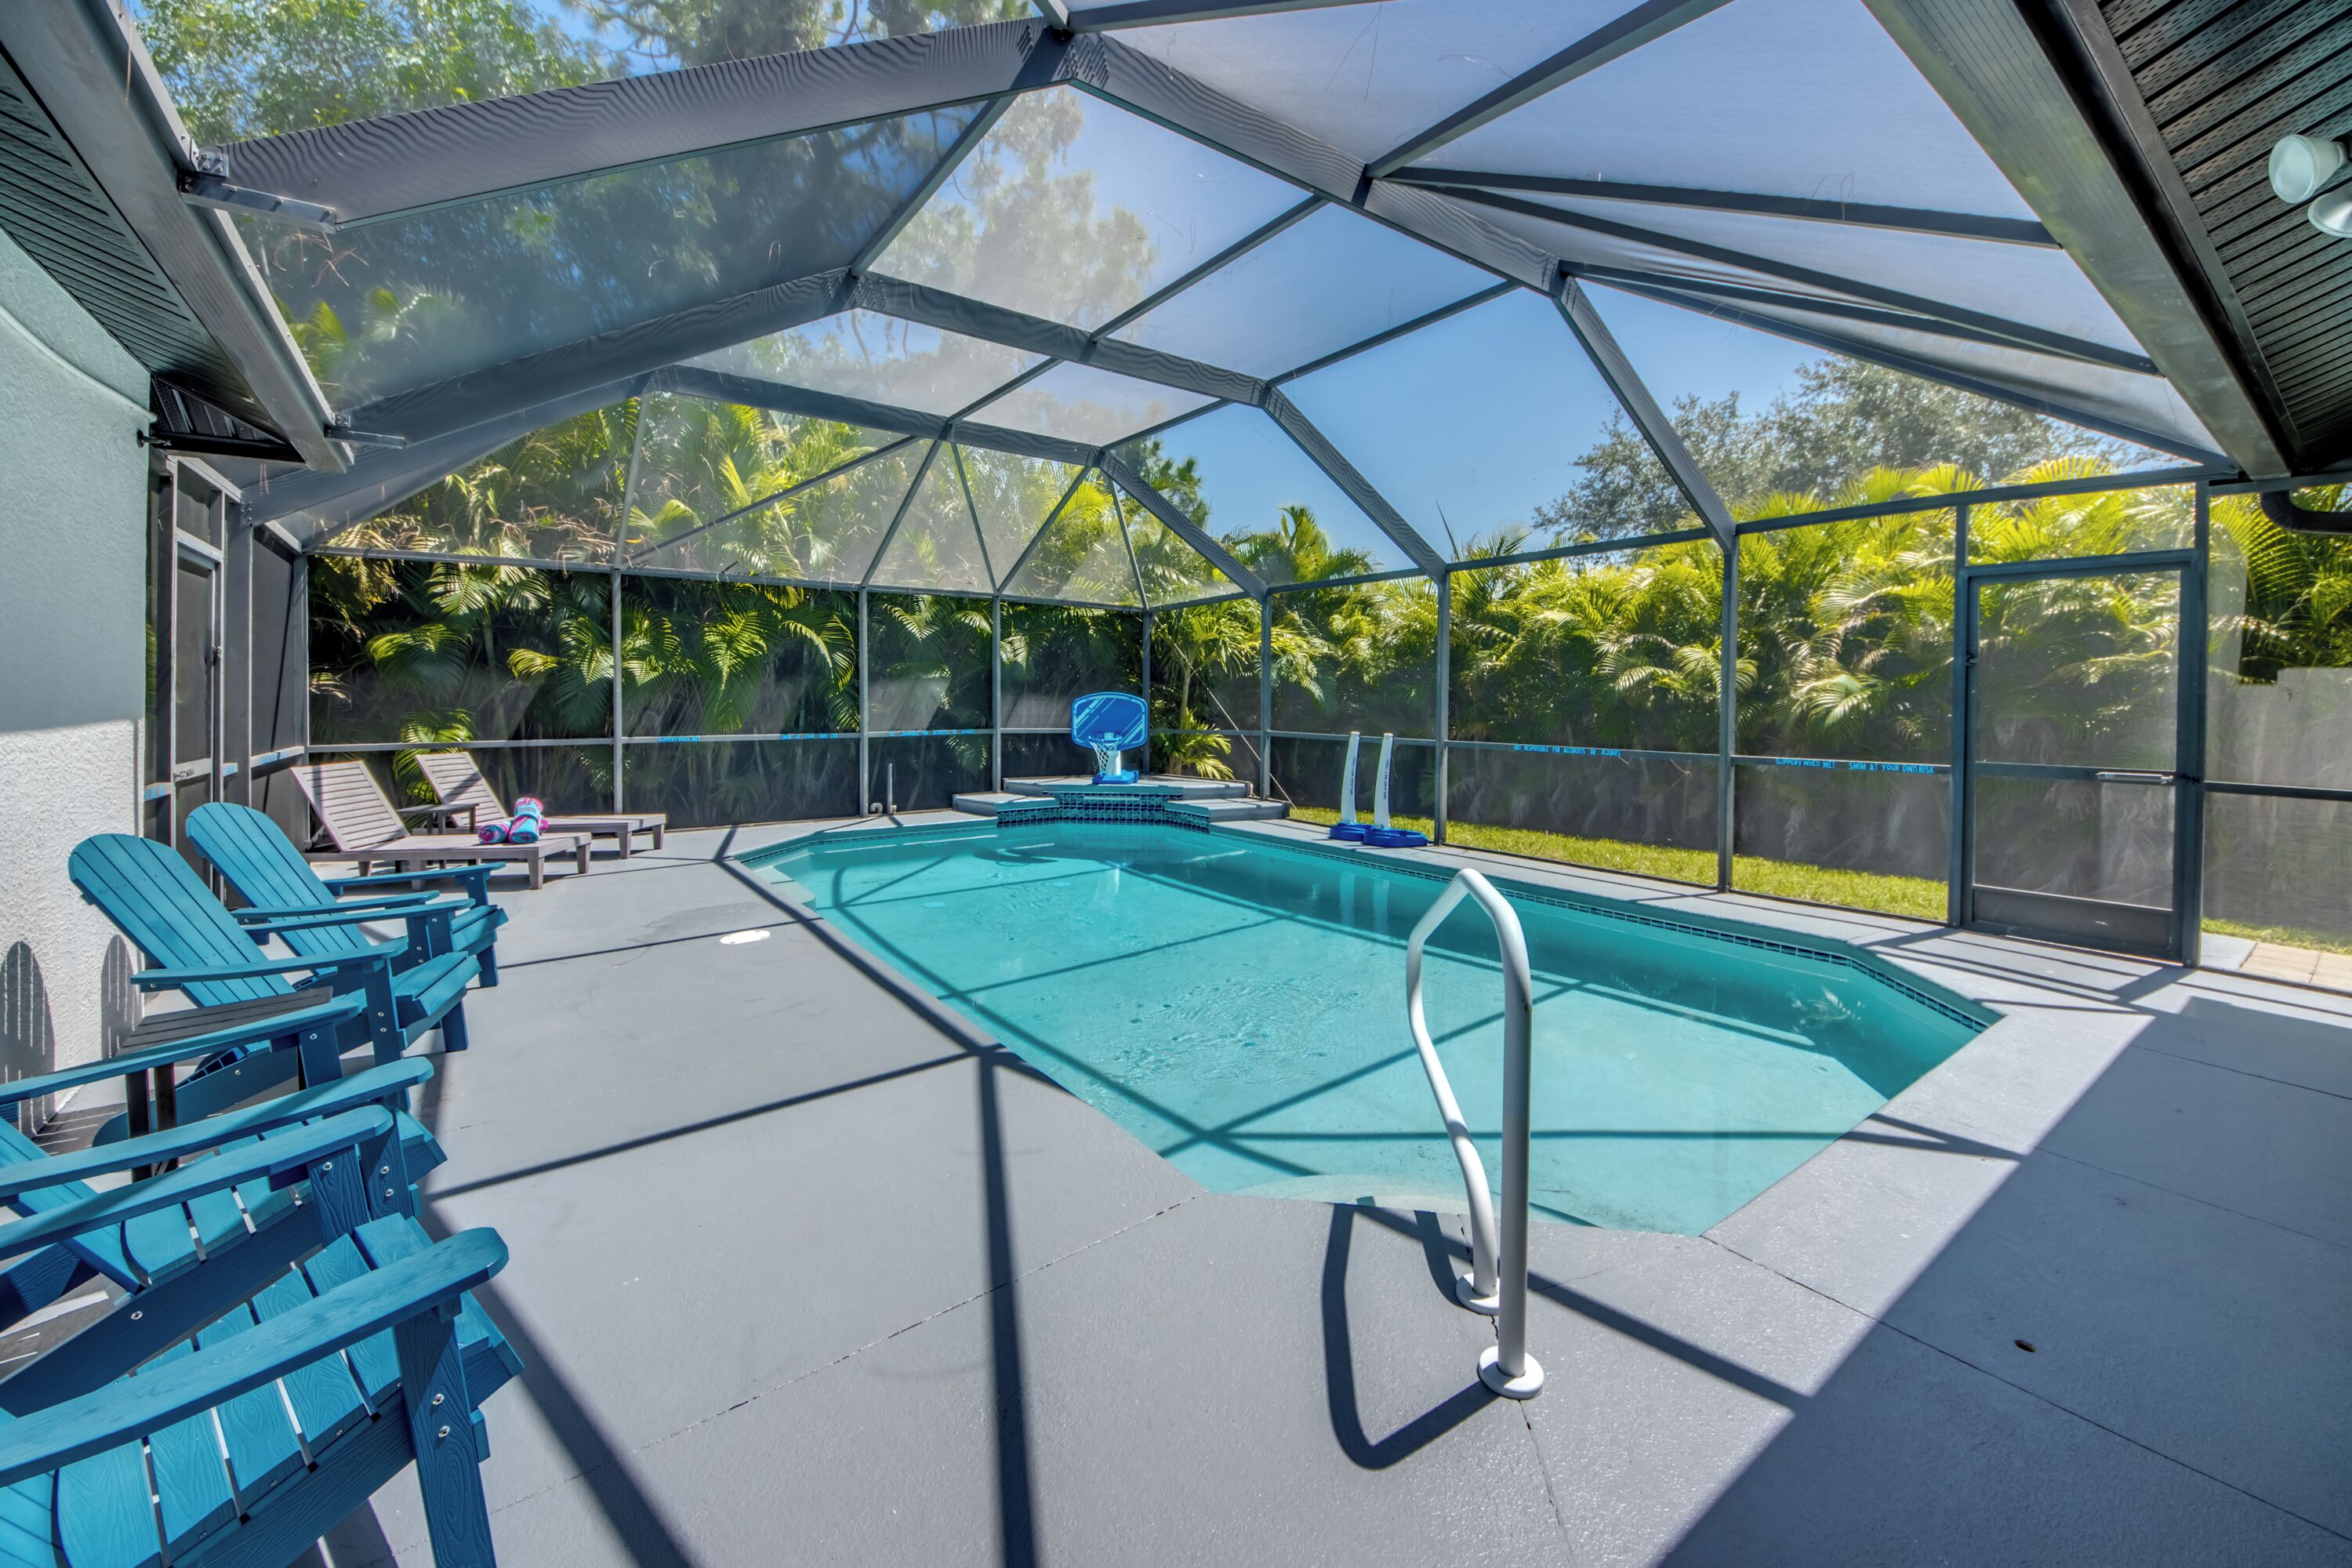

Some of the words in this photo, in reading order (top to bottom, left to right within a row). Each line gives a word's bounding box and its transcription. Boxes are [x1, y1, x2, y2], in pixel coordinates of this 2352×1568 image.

[1775, 758, 1802, 767] SLIPPERY
[1803, 759, 1820, 768] WHEN
[1849, 762, 1866, 771] SWIM
[1869, 763, 1878, 771] AT
[1882, 764, 1900, 772] YOUR
[1901, 764, 1918, 773] OWN
[1918, 765, 1934, 775] RISK
